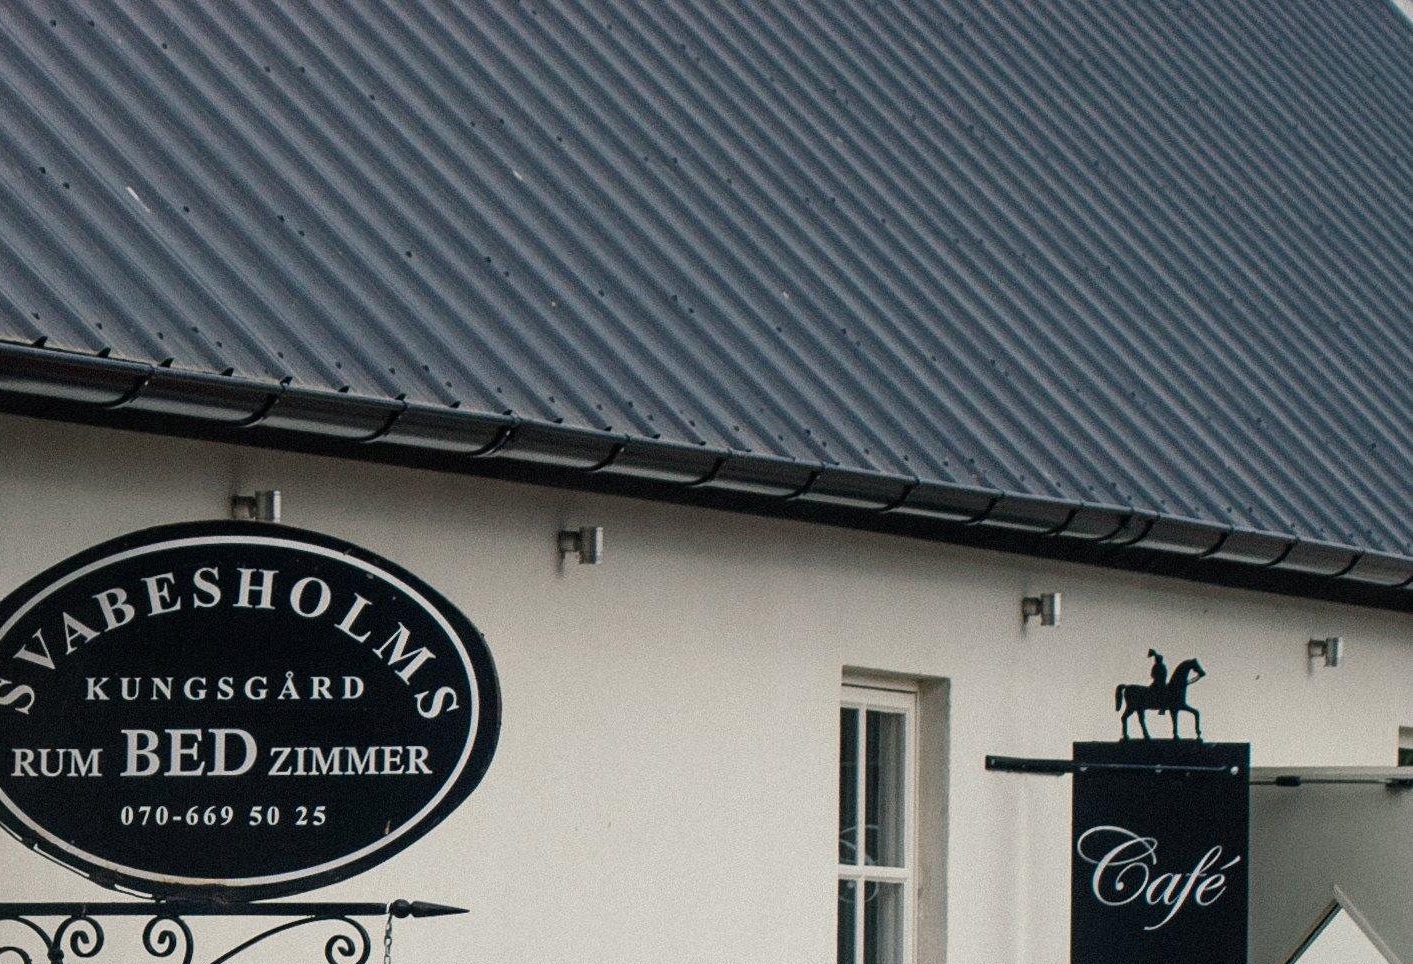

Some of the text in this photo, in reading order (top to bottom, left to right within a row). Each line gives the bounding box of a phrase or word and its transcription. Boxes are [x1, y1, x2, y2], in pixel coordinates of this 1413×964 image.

[85, 671, 366, 701] KUNGSGÅRD
[11, 728, 433, 777] RUM BED ZIMMER
[120, 805, 327, 827] 070-669 50 25
[1077, 825, 1241, 931] Café
